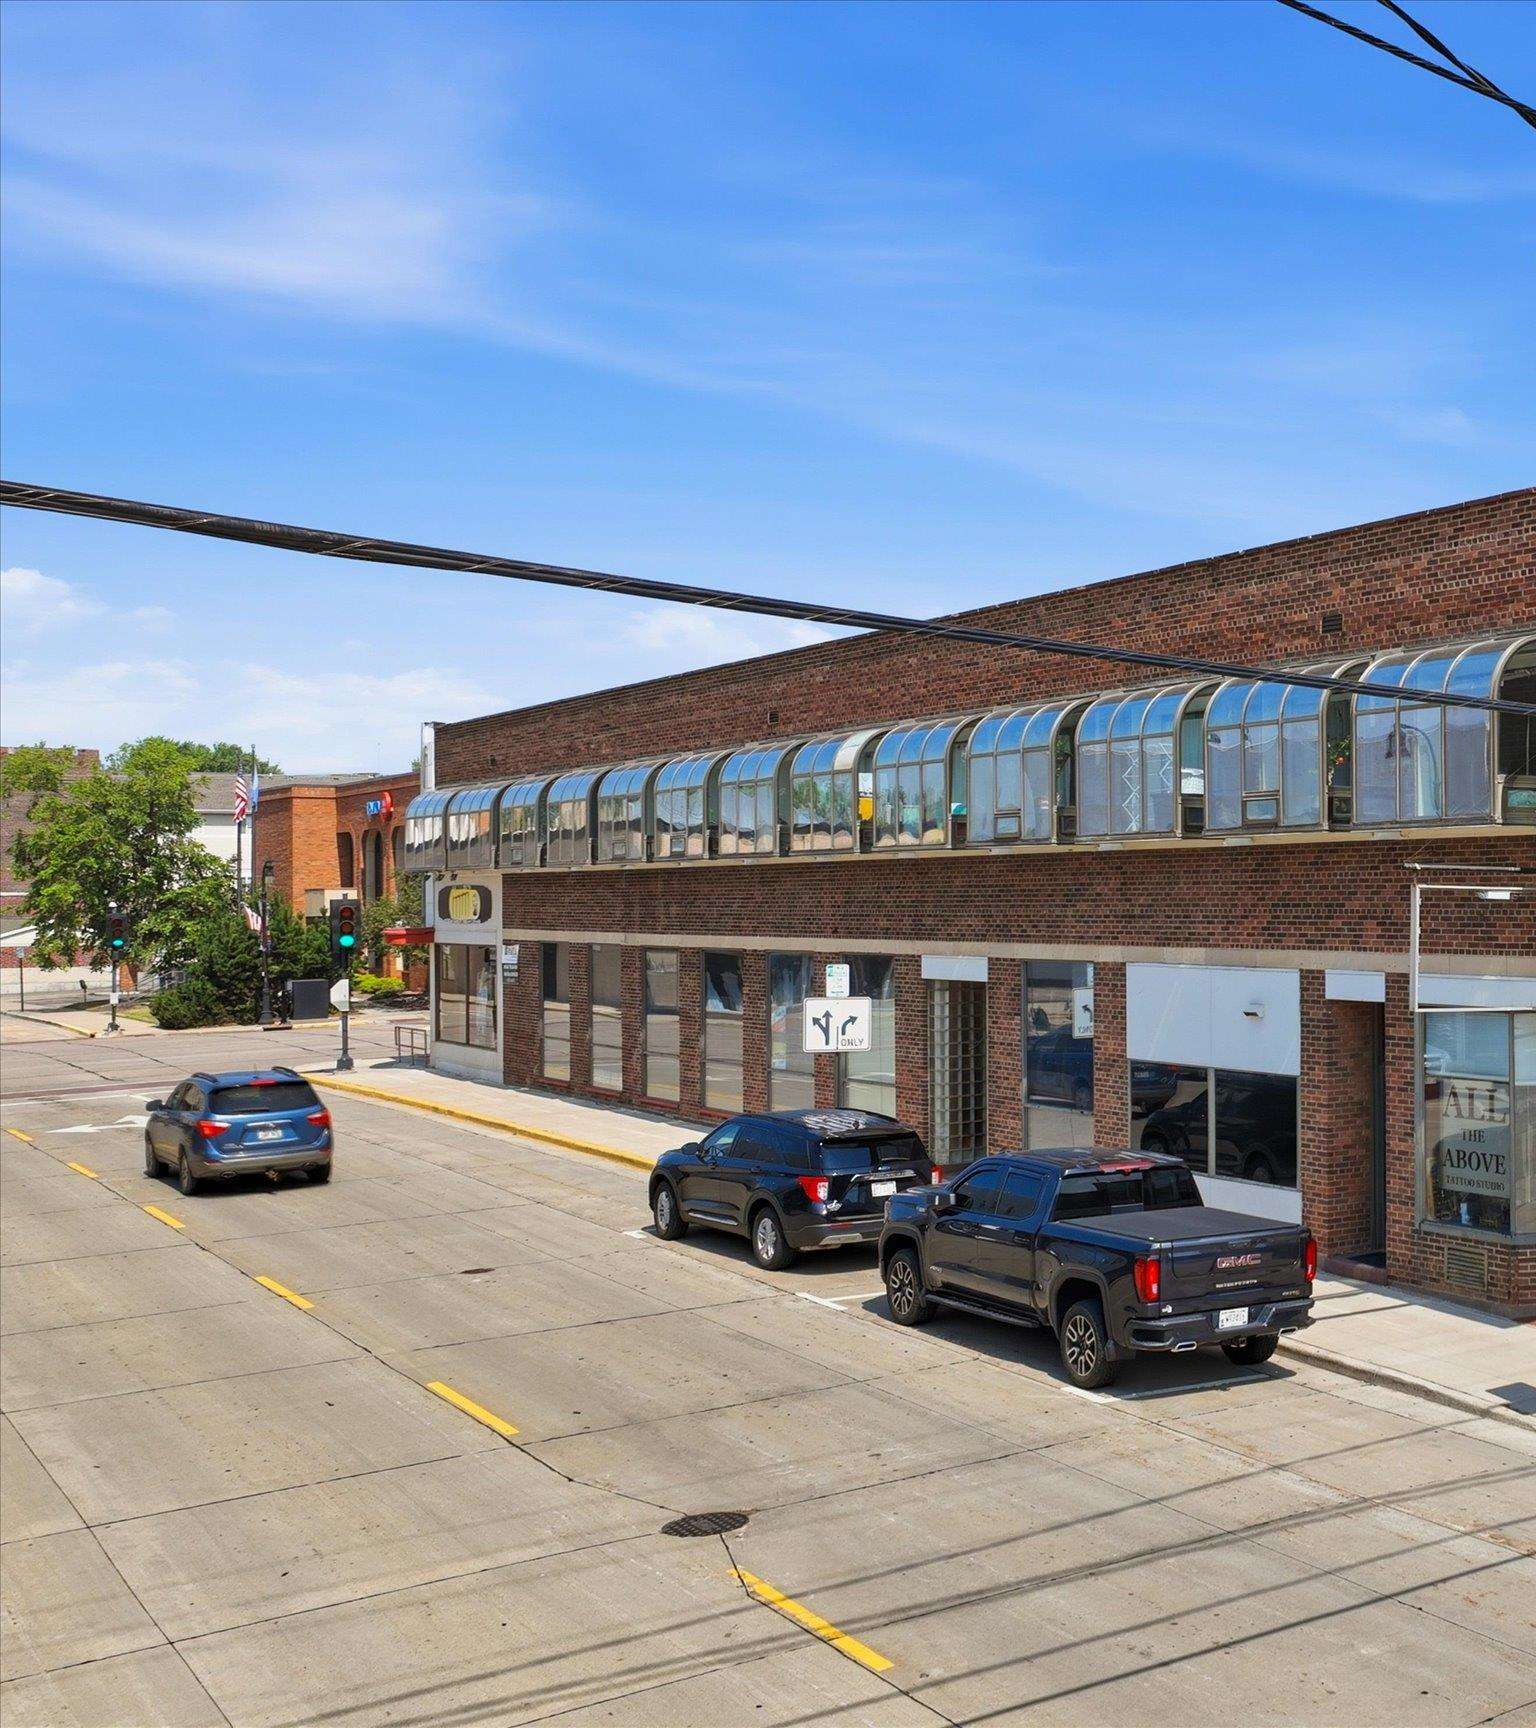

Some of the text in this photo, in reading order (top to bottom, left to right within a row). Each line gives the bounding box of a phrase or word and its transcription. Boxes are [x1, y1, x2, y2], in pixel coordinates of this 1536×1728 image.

[840, 1038, 864, 1047] ONLY
[1442, 1085, 1507, 1124] ALL
[1461, 1128, 1486, 1143] THE
[1442, 1148, 1506, 1175] ABOVE
[1446, 1175, 1505, 1192] TATTOO STUDIO
[1217, 1253, 1261, 1269] GMC
